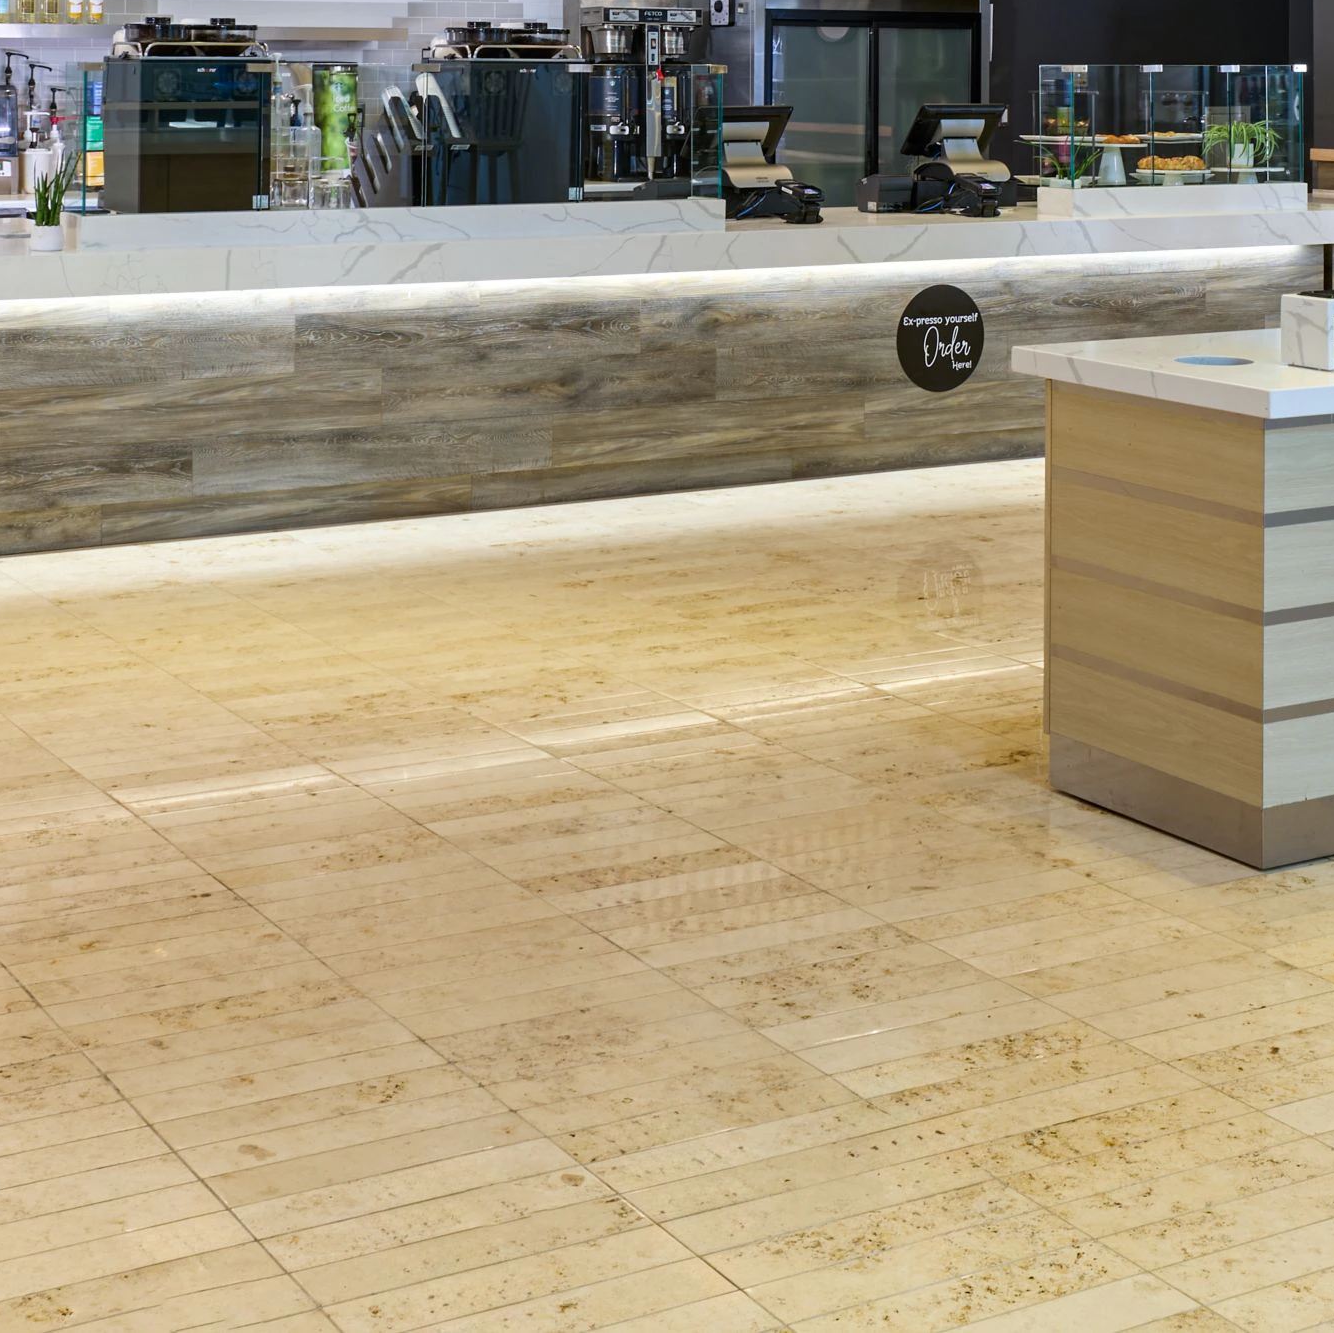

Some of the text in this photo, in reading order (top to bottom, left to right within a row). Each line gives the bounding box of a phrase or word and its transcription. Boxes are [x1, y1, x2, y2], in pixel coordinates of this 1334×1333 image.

[903, 312, 979, 328] Ex-presso yourself
[923, 325, 971, 368] Order
[951, 360, 972, 371] Here!
